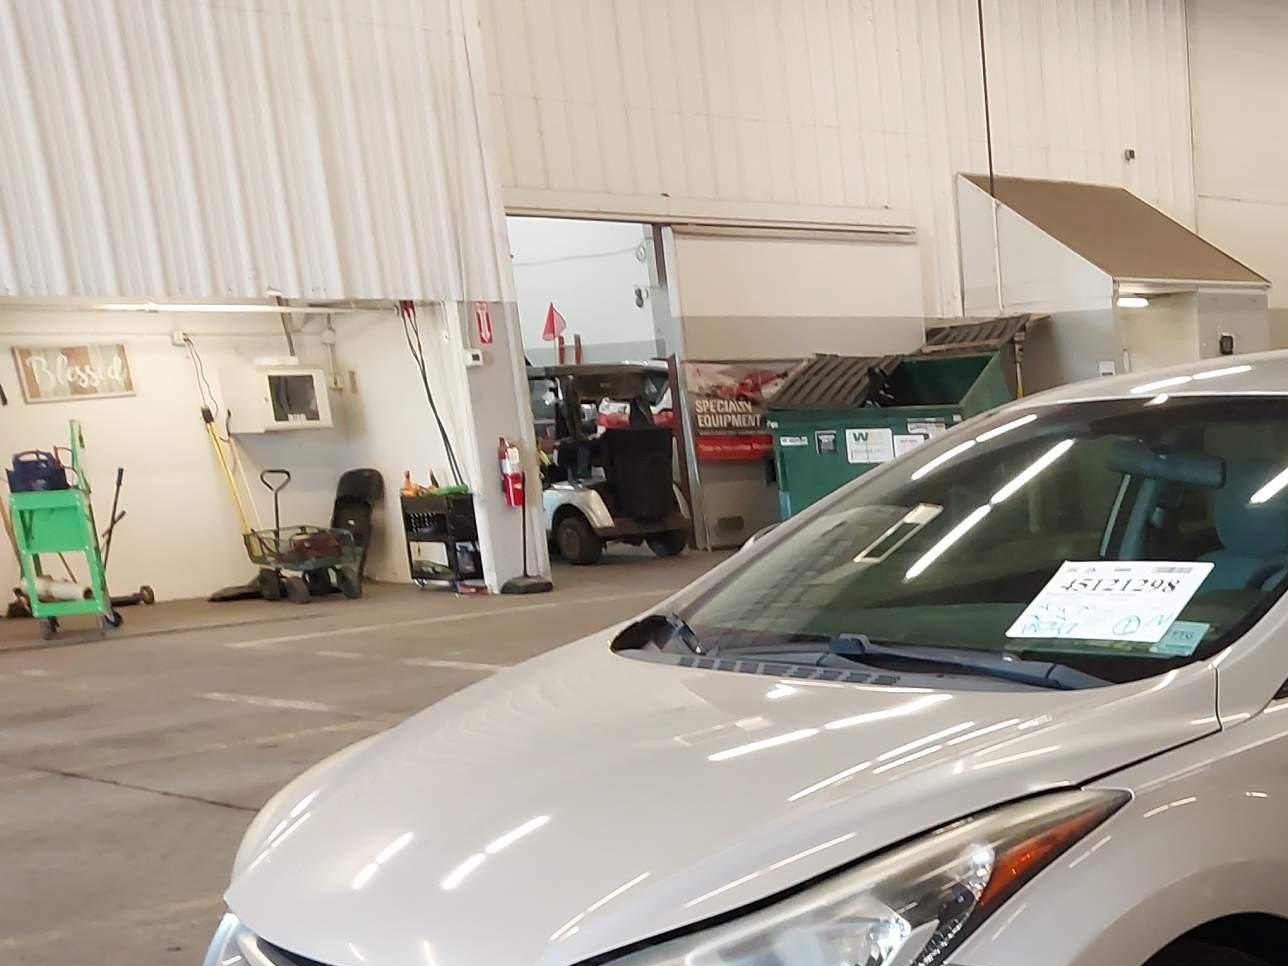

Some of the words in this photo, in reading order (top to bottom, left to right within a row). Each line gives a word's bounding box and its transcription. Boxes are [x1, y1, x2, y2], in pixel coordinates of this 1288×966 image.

[25, 353, 125, 391] Blessed
[695, 400, 752, 413] SPECIALTY
[697, 413, 762, 428] EQUIPMENT
[1061, 578, 1180, 592] 45121298
